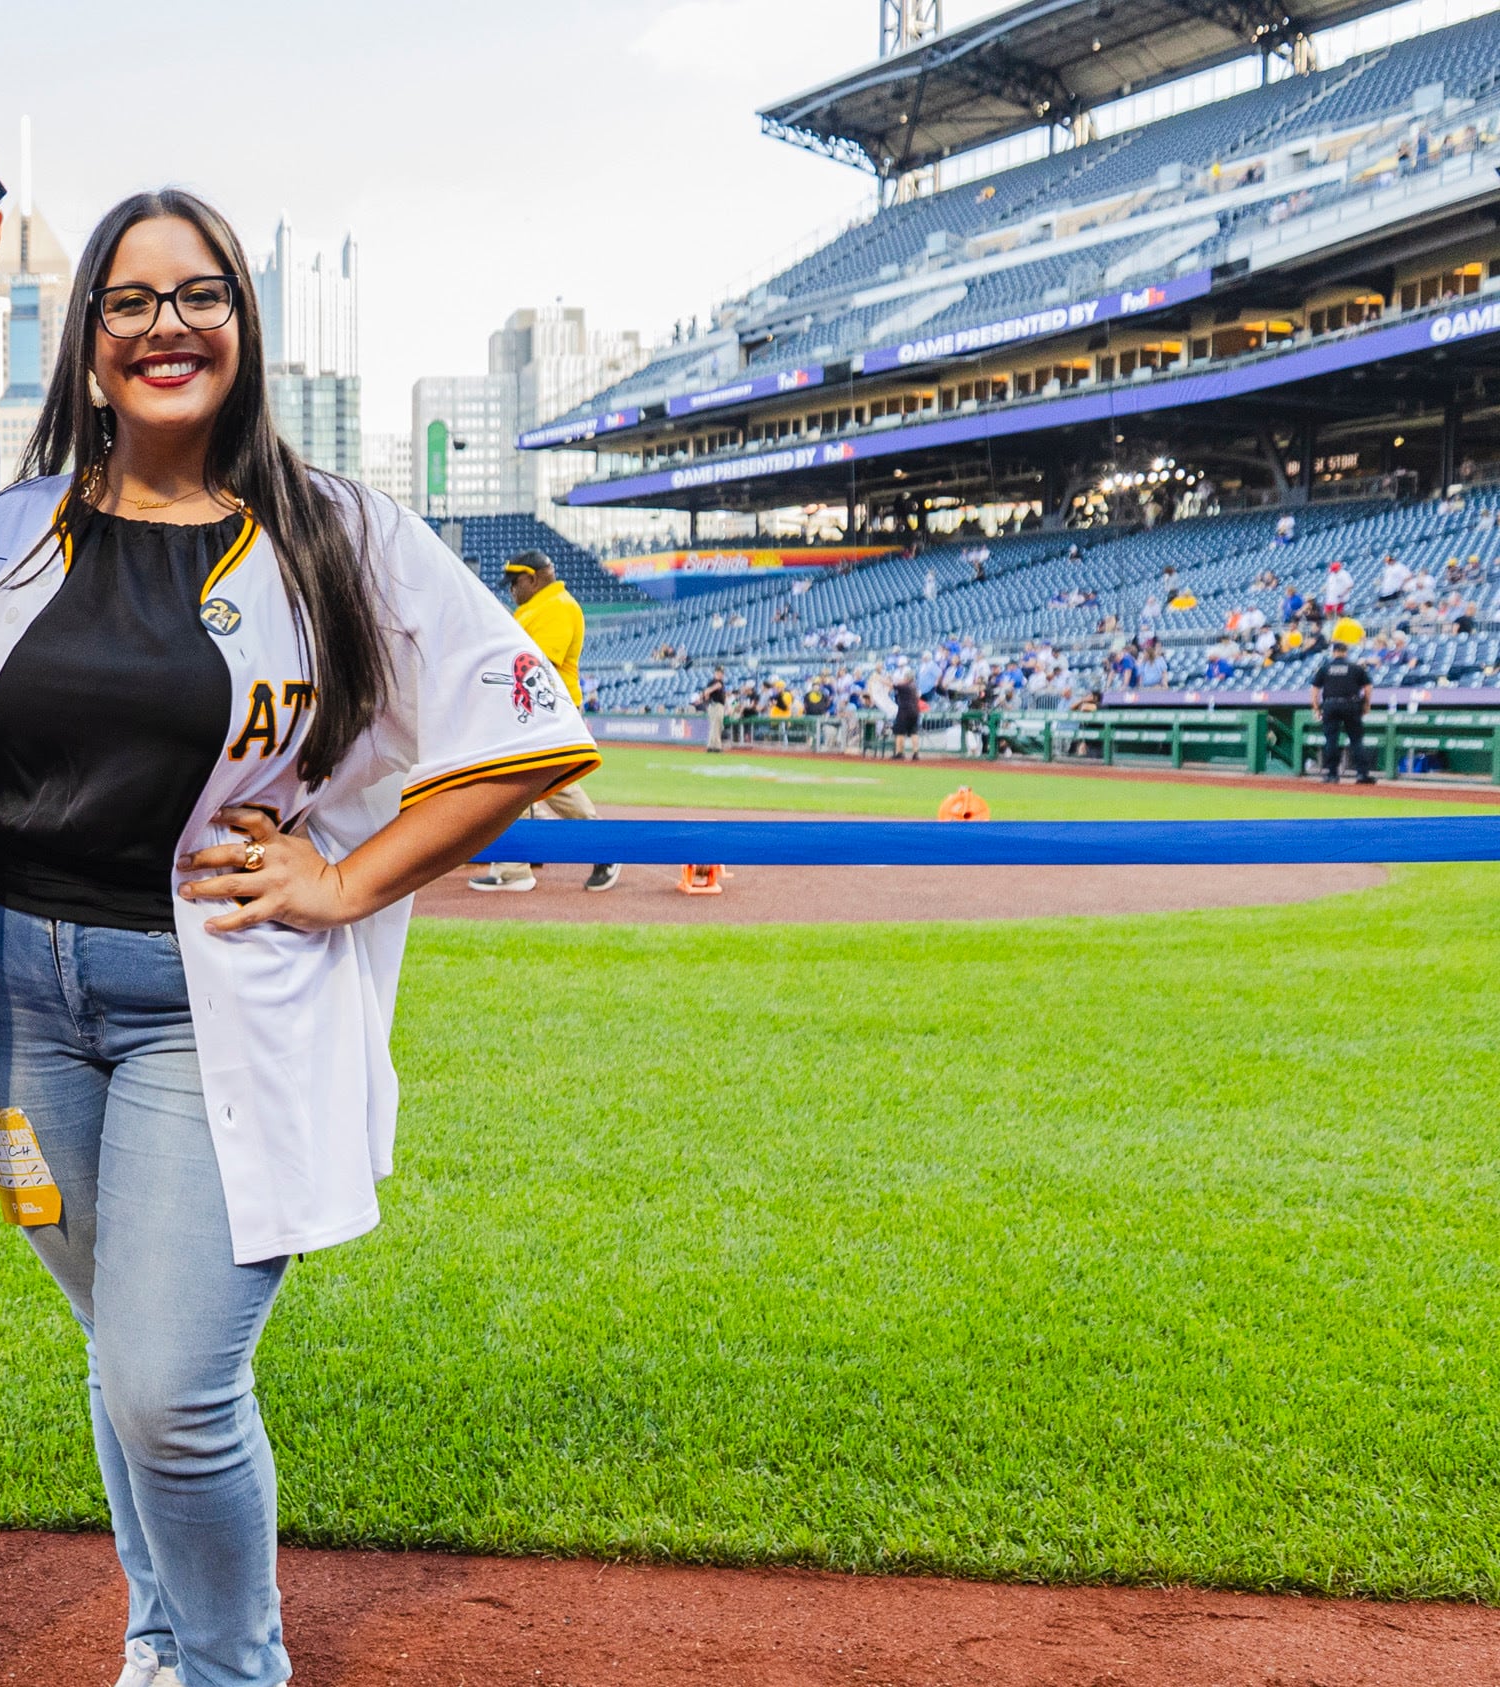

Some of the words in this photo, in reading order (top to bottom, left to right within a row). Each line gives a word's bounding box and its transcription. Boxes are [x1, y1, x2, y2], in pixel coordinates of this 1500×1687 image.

[898, 334, 954, 364] GAME
[955, 308, 1068, 351] PRESENTED
[1068, 300, 1099, 326] BY
[1121, 287, 1166, 314] FedEx
[671, 466, 714, 489] GAME
[714, 451, 794, 481] PRESENTED
[794, 447, 817, 468] BY
